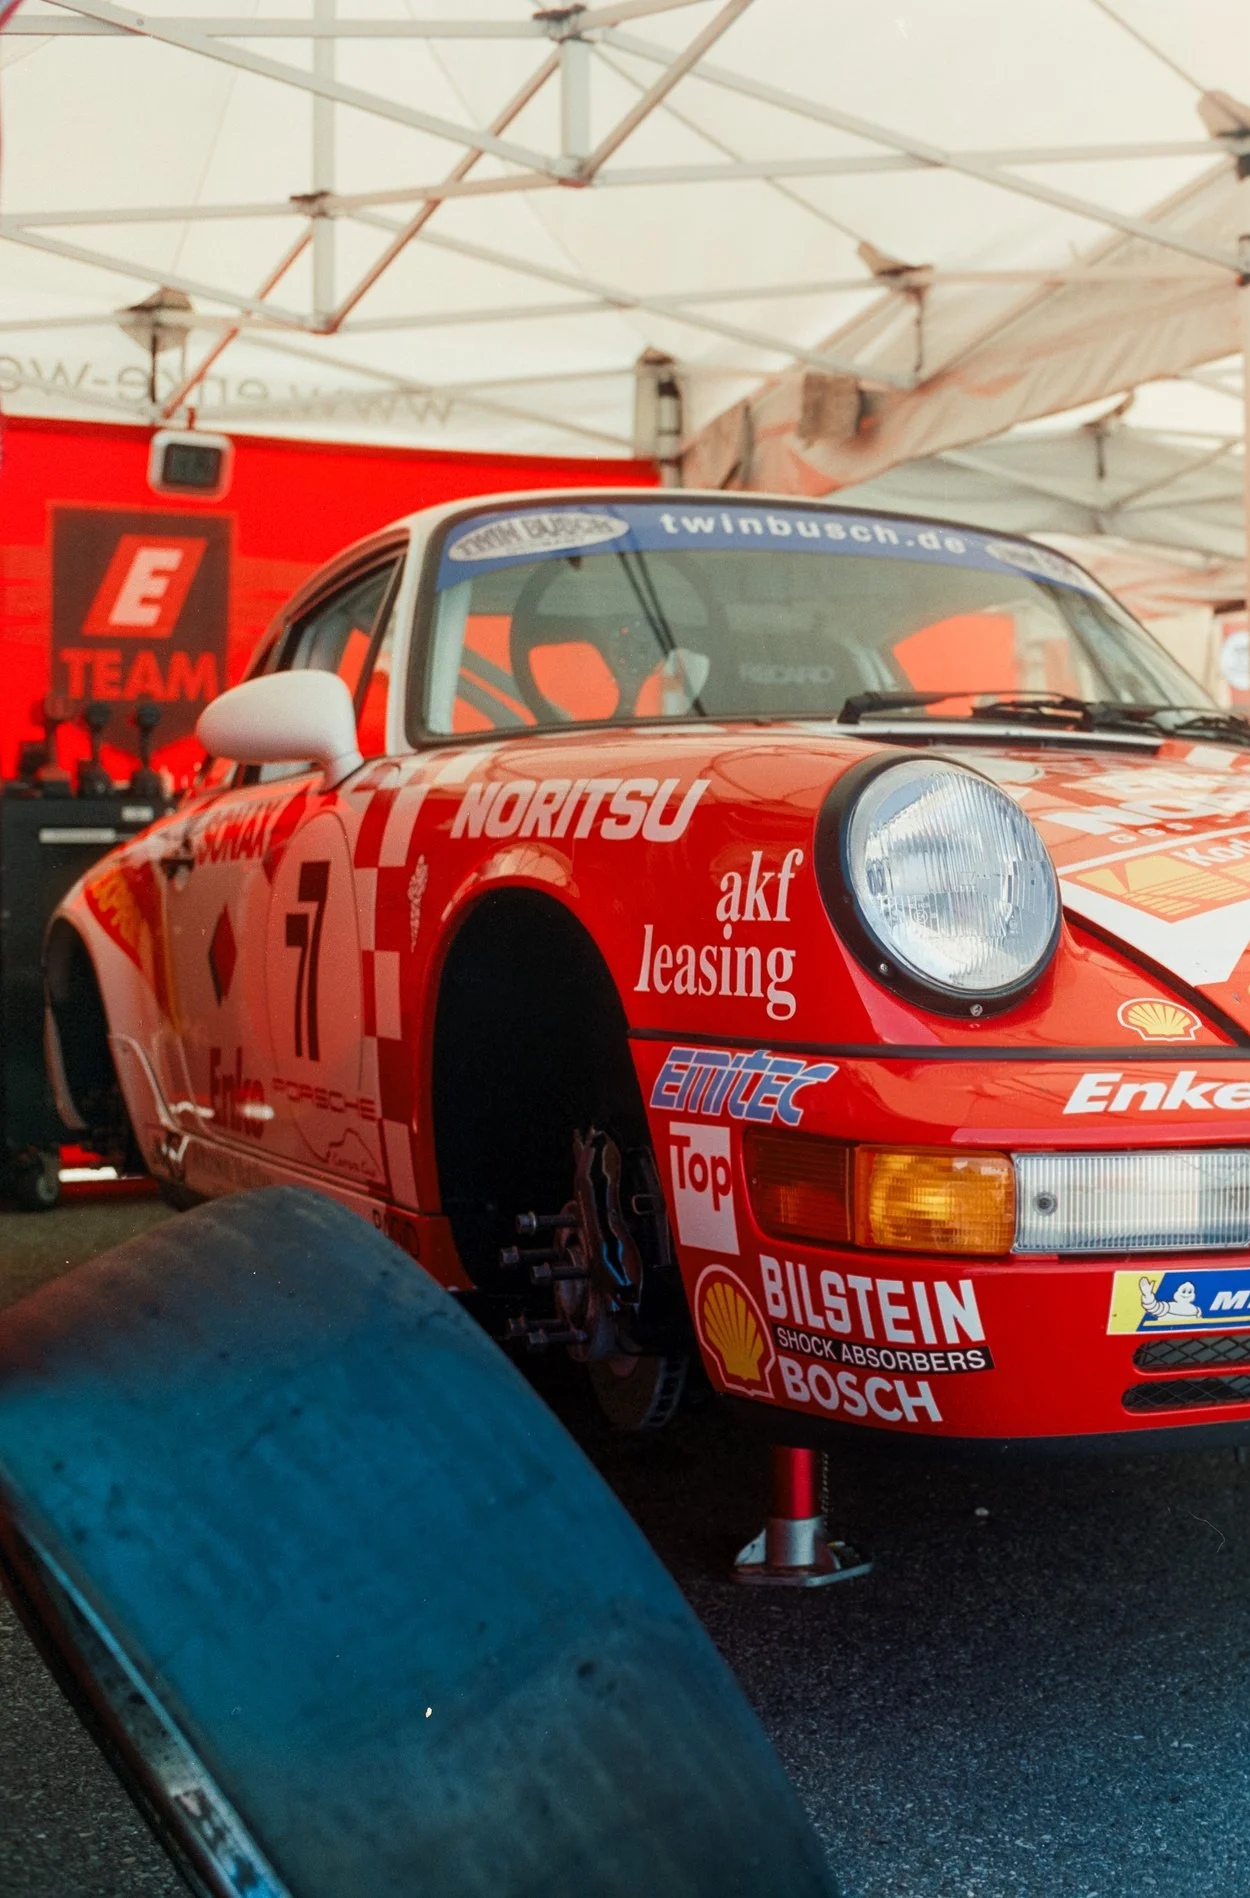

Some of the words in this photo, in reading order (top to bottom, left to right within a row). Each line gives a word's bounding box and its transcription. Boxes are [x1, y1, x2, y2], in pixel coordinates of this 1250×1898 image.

[659, 512, 967, 554] twinbusch.de
[108, 547, 184, 627] E
[60, 648, 219, 702] TEAM
[450, 777, 711, 843] NORITSU
[716, 849, 804, 922] akf
[634, 924, 796, 1021] leasing
[272, 1077, 377, 1122] PORSCHE
[670, 1134, 732, 1212] Top
[759, 1255, 986, 1345] BILSTEIN
[777, 1327, 838, 1361] SHOCK
[841, 1343, 987, 1373] ABSORBERS
[778, 1355, 943, 1422] BOSCH
